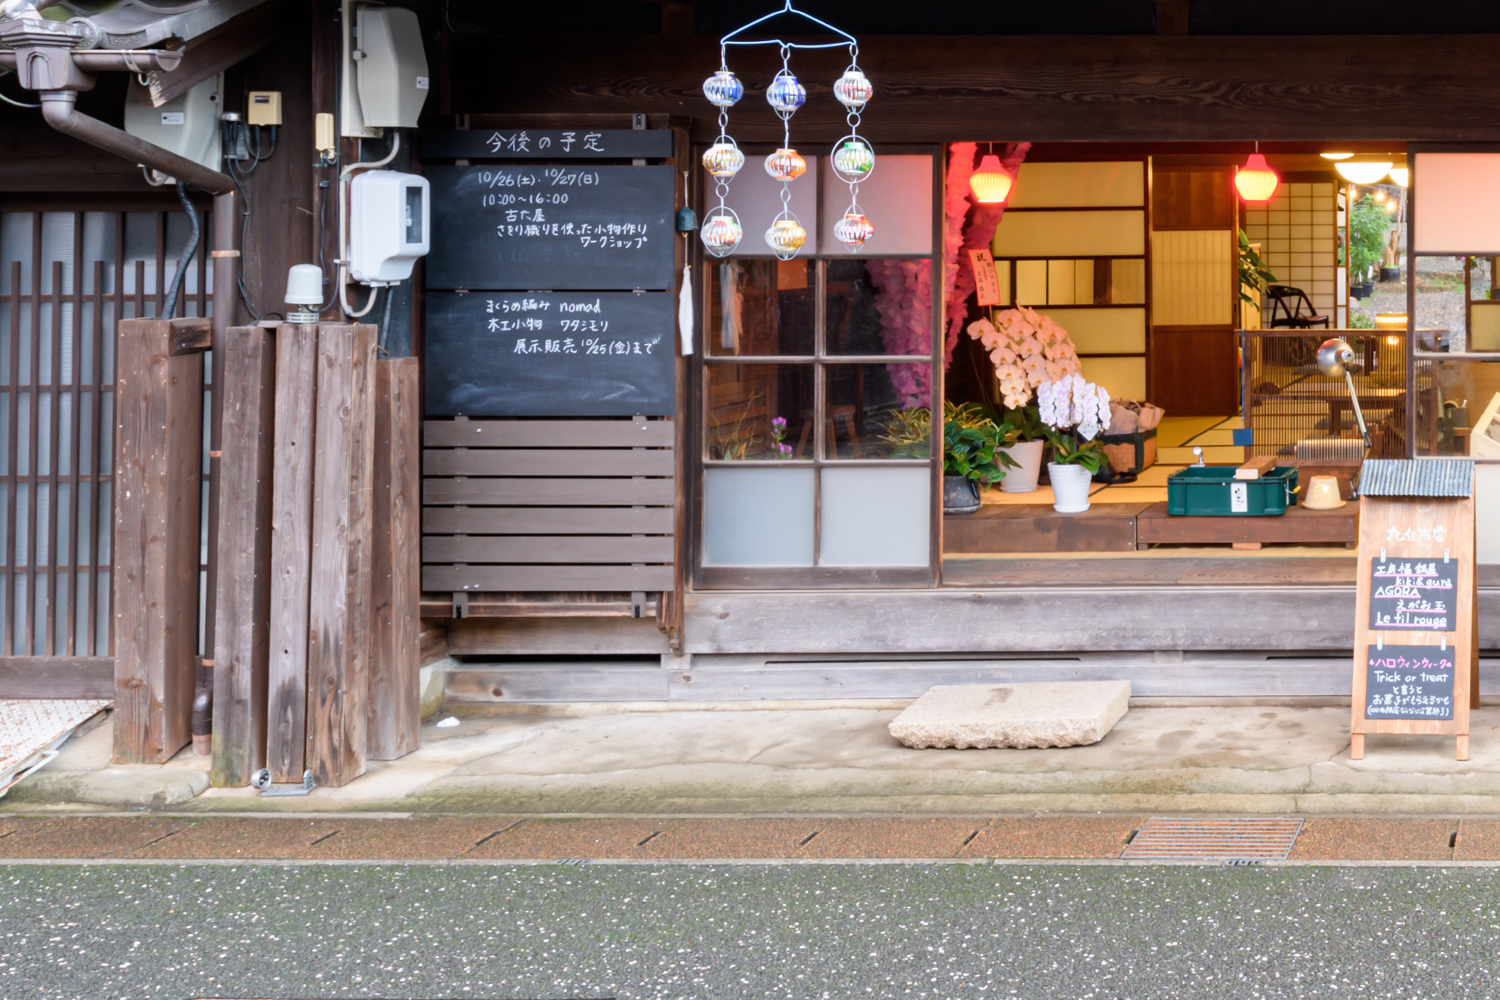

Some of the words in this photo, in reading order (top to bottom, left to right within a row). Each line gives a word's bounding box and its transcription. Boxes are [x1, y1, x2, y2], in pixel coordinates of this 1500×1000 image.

[486, 131, 604, 152] 今後の予定
[580, 236, 648, 249] ワークショップ
[559, 298, 601, 313] nomad
[487, 317, 543, 332] 木工小物
[1375, 585, 1420, 596] AGORA
[1376, 611, 1391, 624] Le
[1393, 611, 1410, 624] fil
[1414, 615, 1448, 629] rouge
[1373, 670, 1401, 682] Trick
[1420, 672, 1449, 682] treat
[1392, 684, 1423, 695] と言うと
